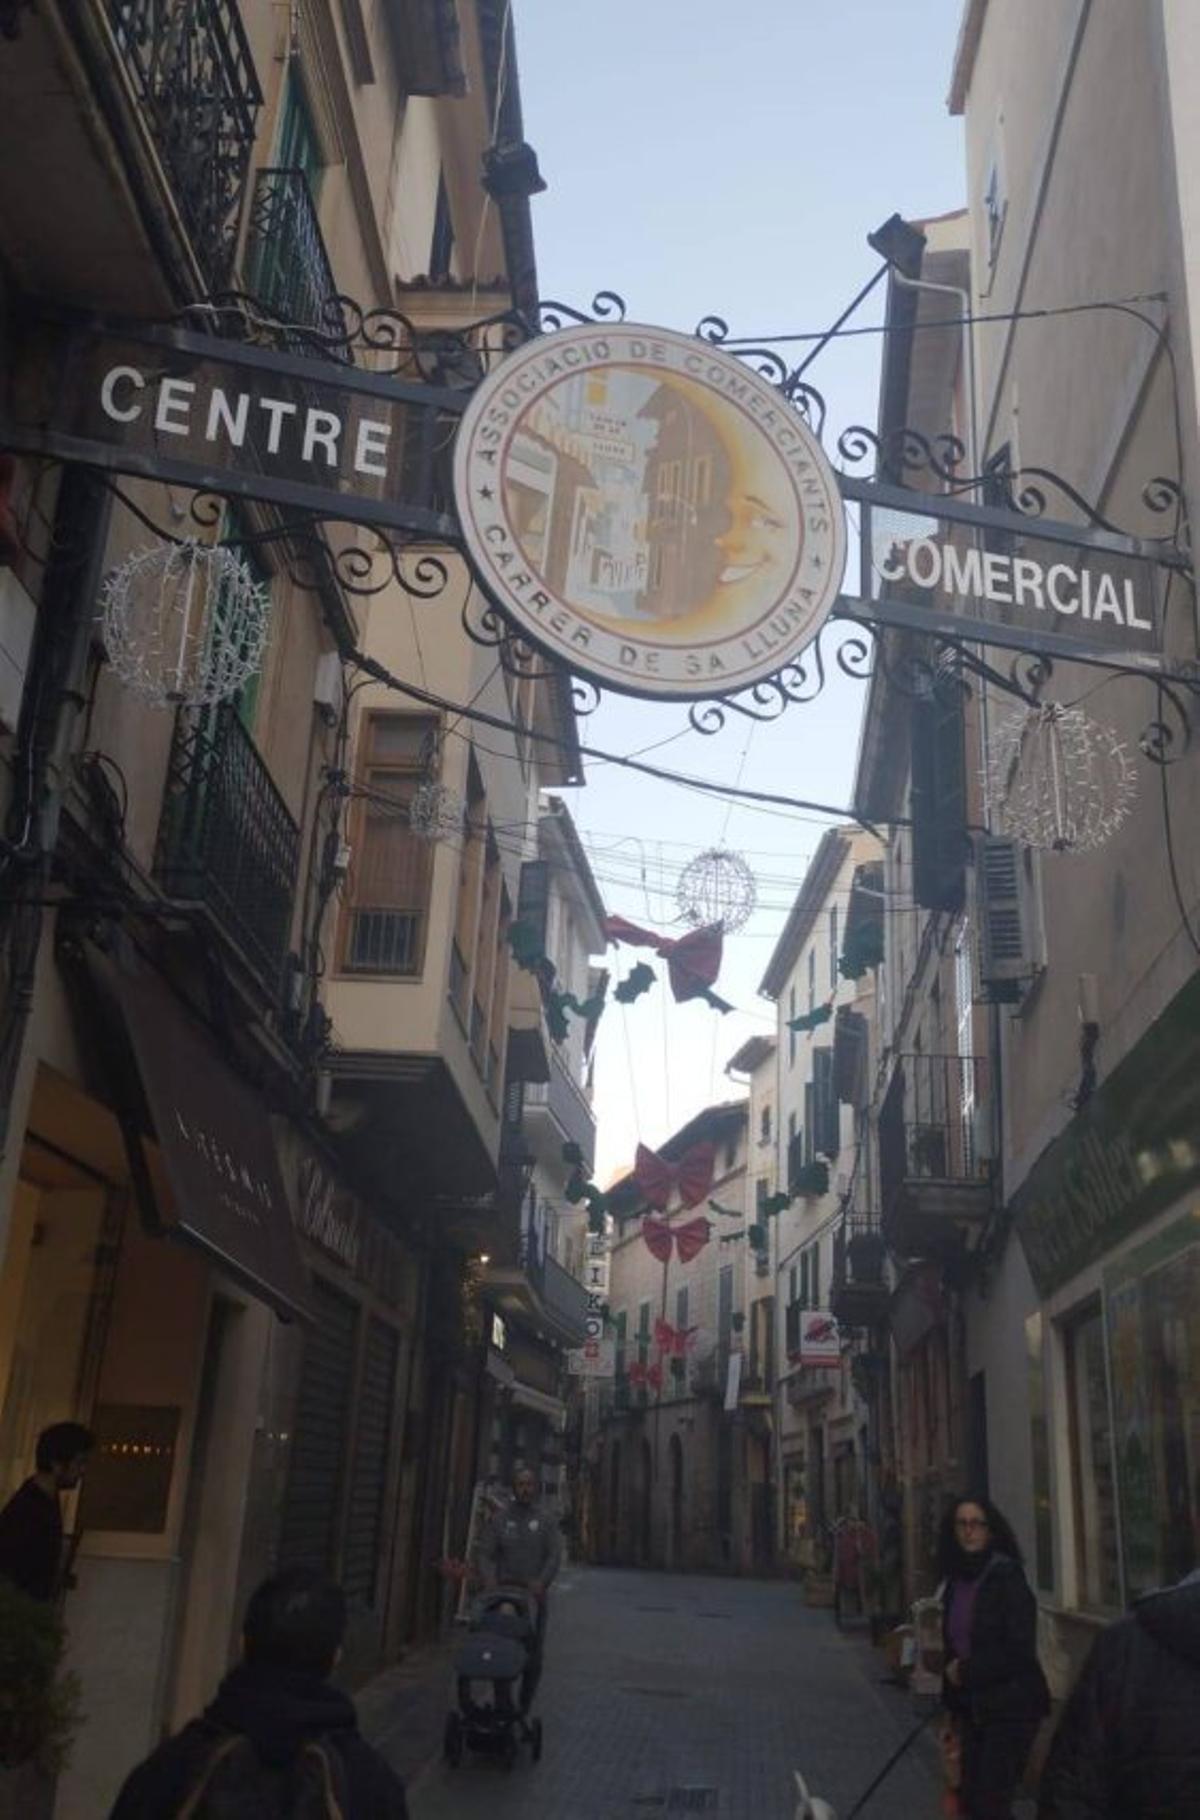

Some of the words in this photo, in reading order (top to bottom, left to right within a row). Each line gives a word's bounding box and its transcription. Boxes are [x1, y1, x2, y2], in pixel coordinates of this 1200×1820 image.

[101, 365, 392, 478] CENTRE
[630, 340, 668, 363] DE
[684, 355, 828, 534] COMERCIANTS
[485, 525, 593, 647] CARRER
[620, 645, 660, 673] DE
[686, 653, 726, 676] SA
[741, 587, 818, 658] LLUNA
[872, 535, 1152, 631] COMERCIAL
[585, 1241, 605, 1336] EIKO
